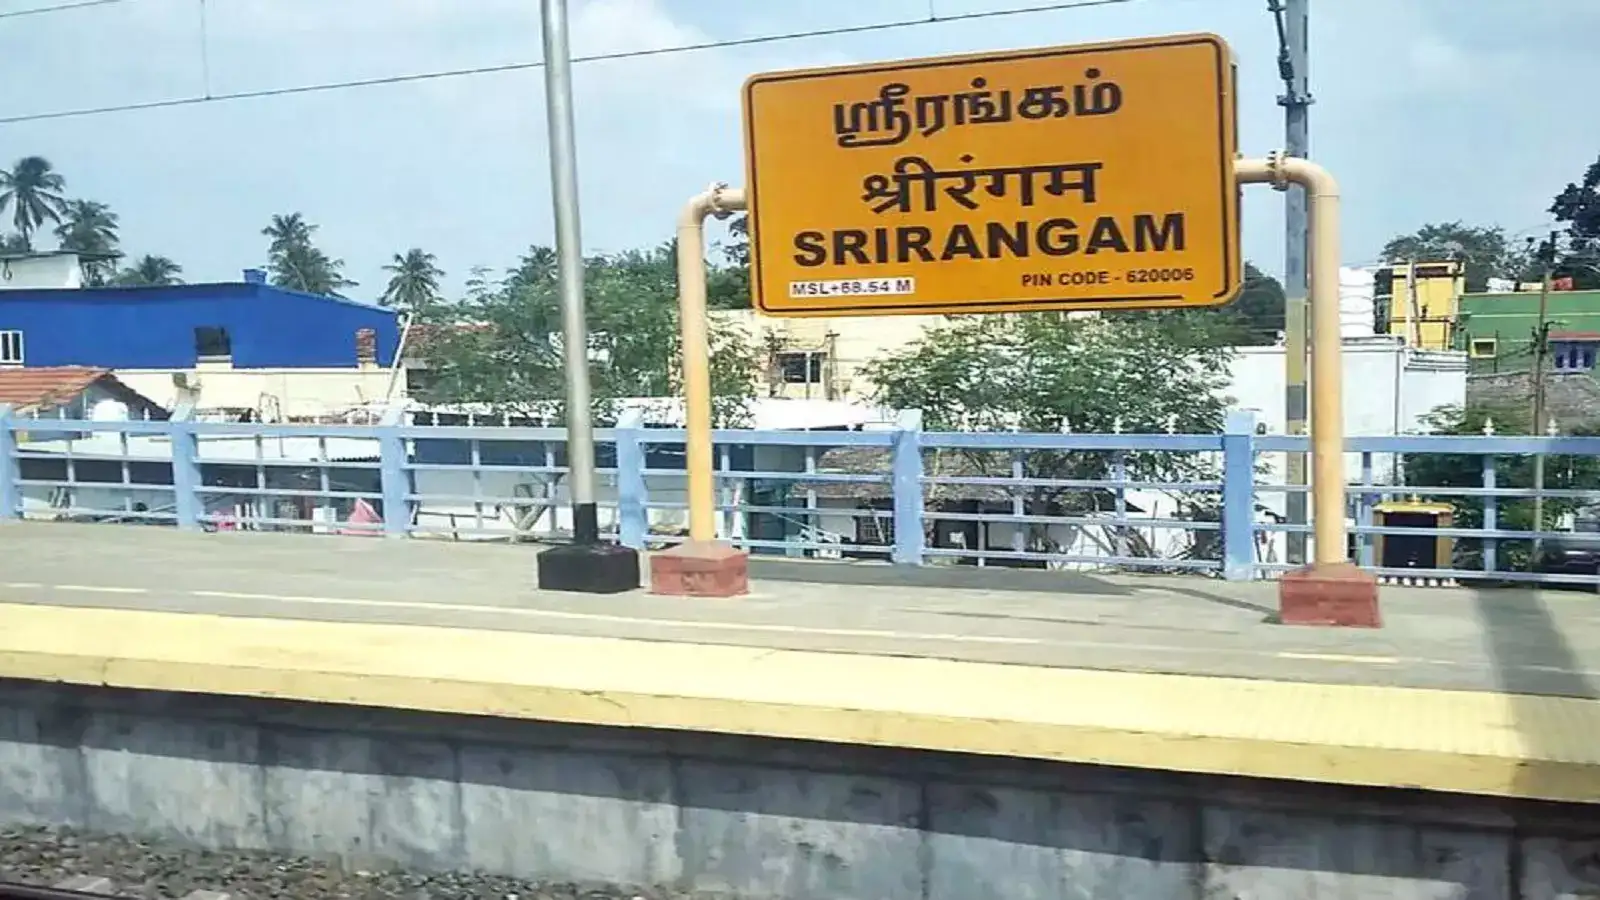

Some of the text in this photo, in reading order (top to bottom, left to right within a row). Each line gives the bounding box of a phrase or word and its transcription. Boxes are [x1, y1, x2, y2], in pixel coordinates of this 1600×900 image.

[862, 154, 1104, 215] श्रीरंगम
[793, 213, 1186, 267] SRIRANGAM
[896, 279, 911, 293] M
[1021, 273, 1052, 287] PIN
[1058, 270, 1110, 286] CODE
[1126, 268, 1194, 283] 620006
